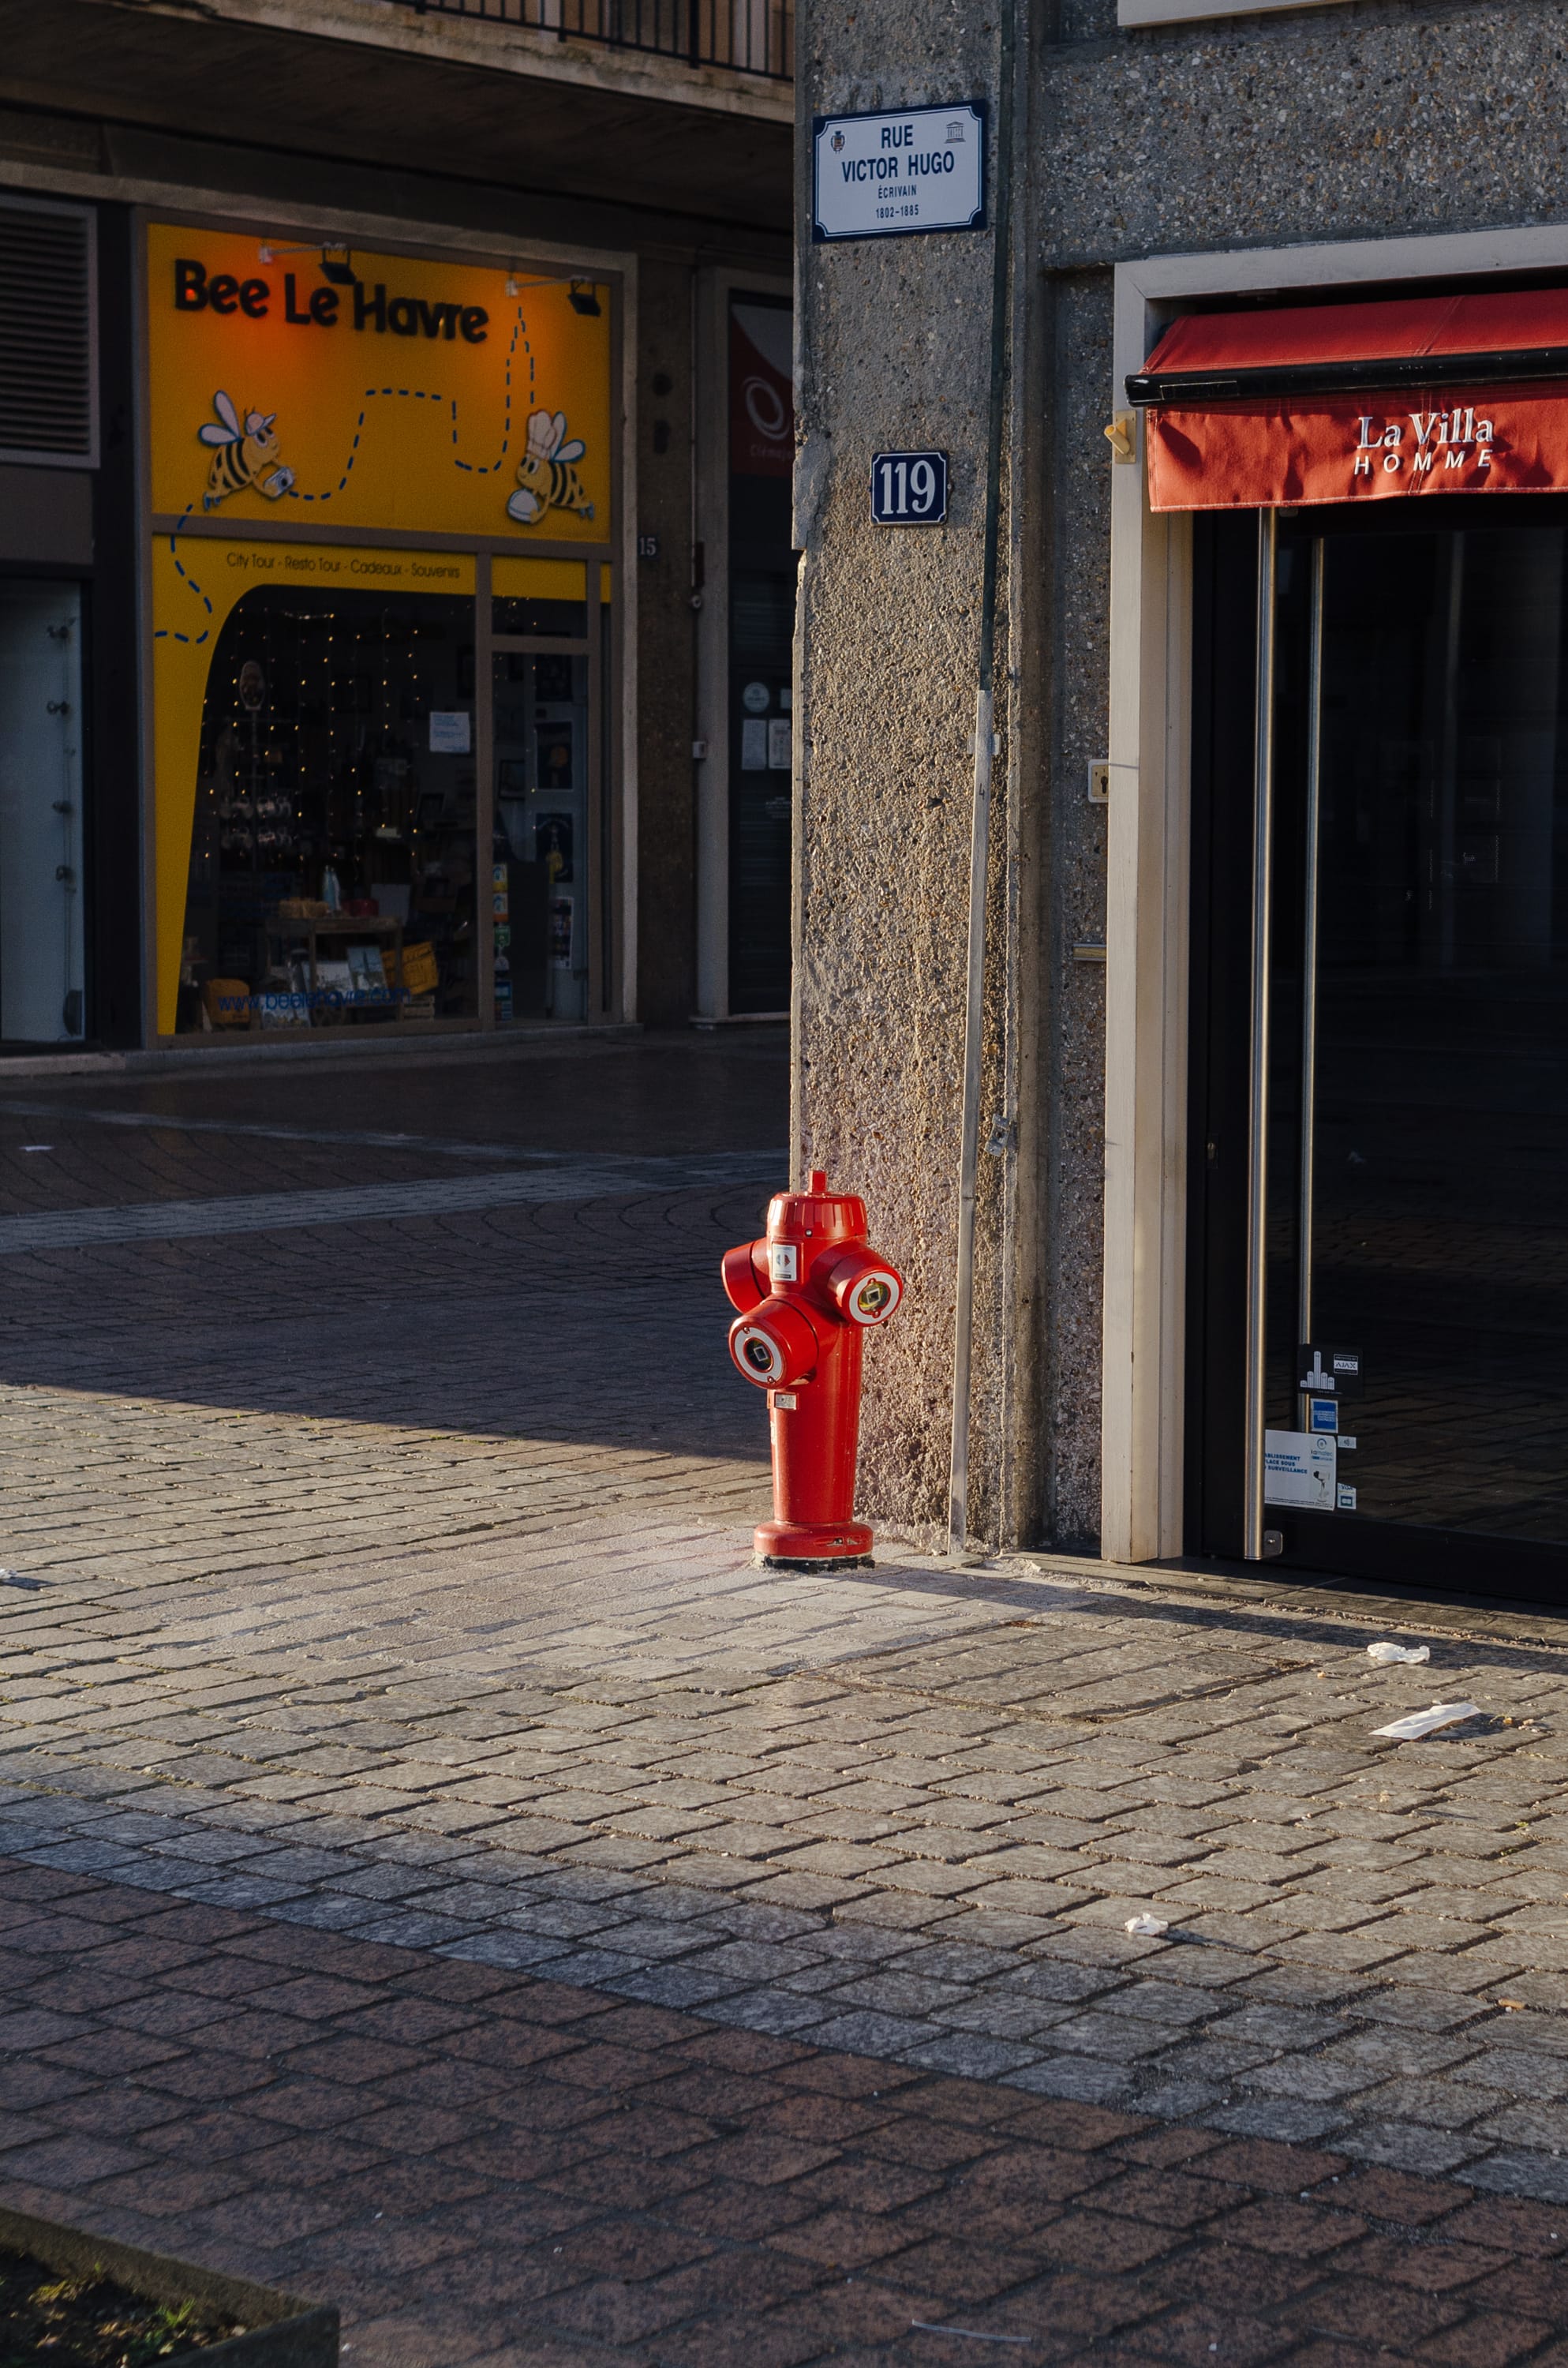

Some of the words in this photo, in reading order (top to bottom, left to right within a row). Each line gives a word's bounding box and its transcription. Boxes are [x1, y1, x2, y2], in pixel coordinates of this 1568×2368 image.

[881, 125, 914, 148] RUE
[841, 156, 898, 182] VICTOR
[908, 151, 955, 176] HUGO
[878, 185, 917, 199] ÉCRIVAIN
[875, 204, 919, 219] 1802-1885
[174, 258, 270, 317] Bee
[284, 272, 339, 327] Le
[354, 281, 489, 344] Havre
[1357, 416, 1401, 449] La
[1408, 407, 1495, 445] Villa
[1353, 448, 1493, 475] HOMME
[880, 460, 935, 515] 119
[638, 536, 657, 556] 15
[226, 553, 249, 569] City
[252, 553, 275, 568] Tour
[285, 556, 316, 571] Resto
[319, 557, 341, 572] Tour
[350, 559, 402, 575] Cadeaux
[411, 562, 460, 579] Souvenirs
